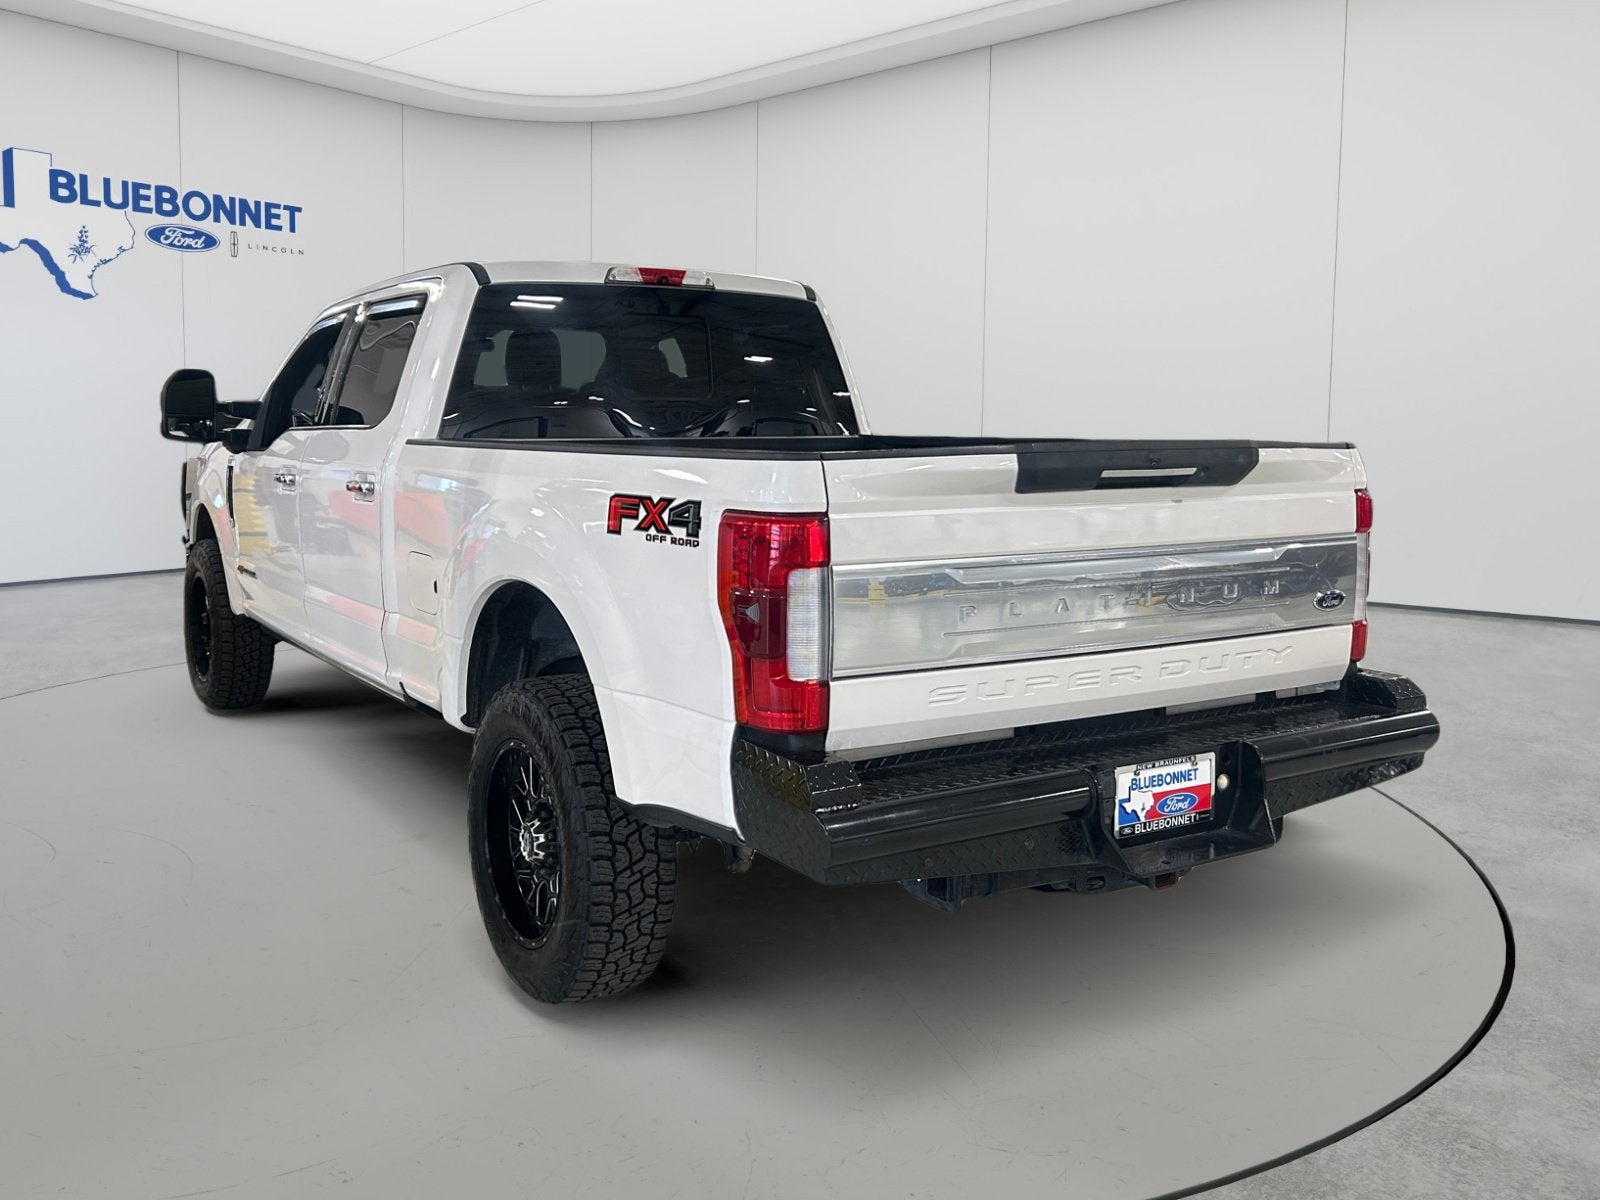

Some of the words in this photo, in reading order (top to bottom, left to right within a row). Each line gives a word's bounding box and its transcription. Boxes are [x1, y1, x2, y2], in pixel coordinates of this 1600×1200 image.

[49, 168, 302, 233] BLUEBONNET
[159, 229, 206, 250] Ford
[247, 243, 304, 255] LINCOLN
[606, 493, 702, 539] FX4
[645, 533, 667, 544] OFF
[670, 536, 700, 548] ROAD
[928, 665, 1142, 707] SUPER
[1159, 645, 1294, 679] DUTY
[1137, 762, 1153, 771] NEW
[1130, 768, 1199, 791] BLUEBONNET
[1164, 794, 1191, 813] Ford
[1134, 813, 1197, 834] BLUEBONNET
